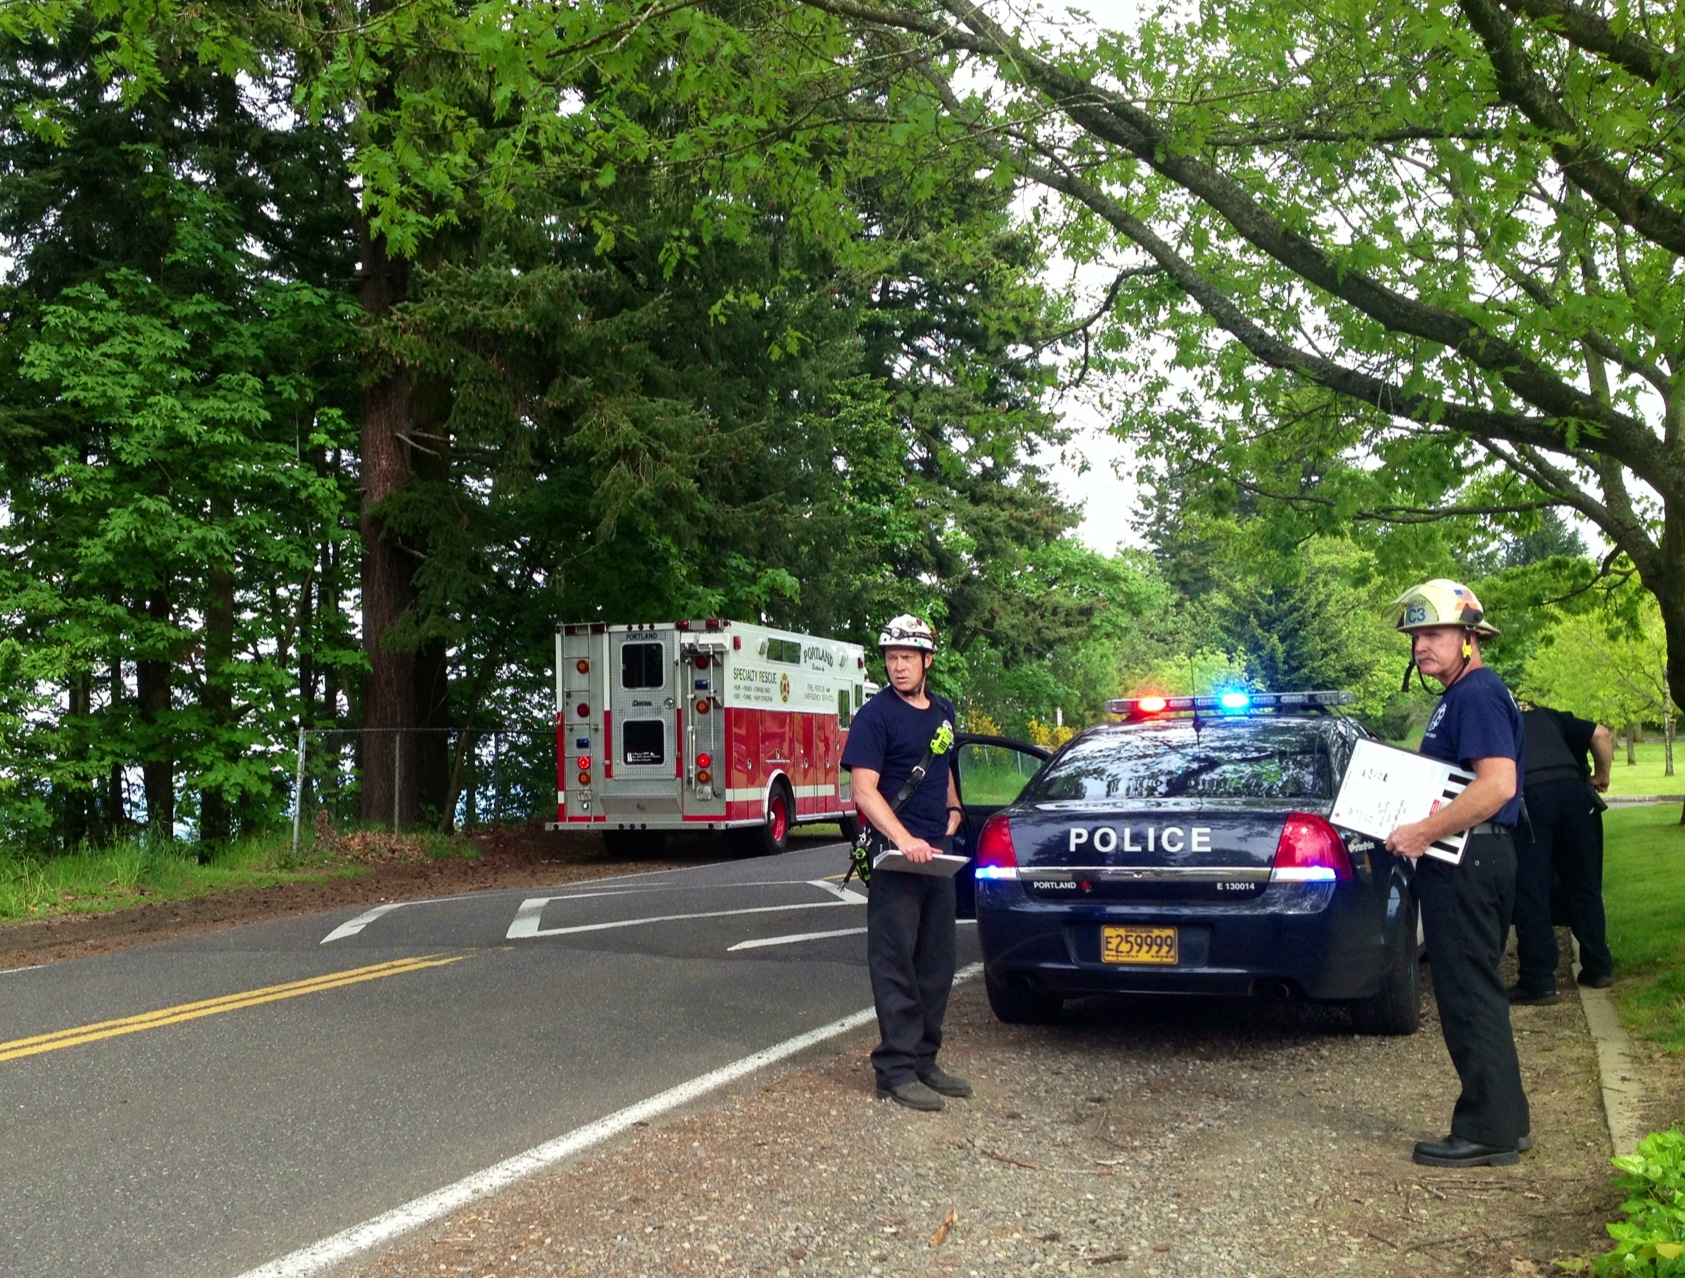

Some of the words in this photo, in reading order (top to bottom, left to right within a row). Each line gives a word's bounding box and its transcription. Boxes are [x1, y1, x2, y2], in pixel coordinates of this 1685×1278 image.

[1408, 607, 1426, 623] C3
[626, 632, 658, 640] PORTLAND
[803, 646, 834, 667] PORTLAND
[733, 667, 758, 682] SPECIALTY
[758, 670, 777, 684] RESCUE
[1069, 827, 1212, 852] POLICE
[1033, 881, 1077, 889] PORTLAND
[1217, 883, 1224, 891] E
[1225, 882, 1255, 891] 130014
[1105, 934, 1174, 955] E259999
